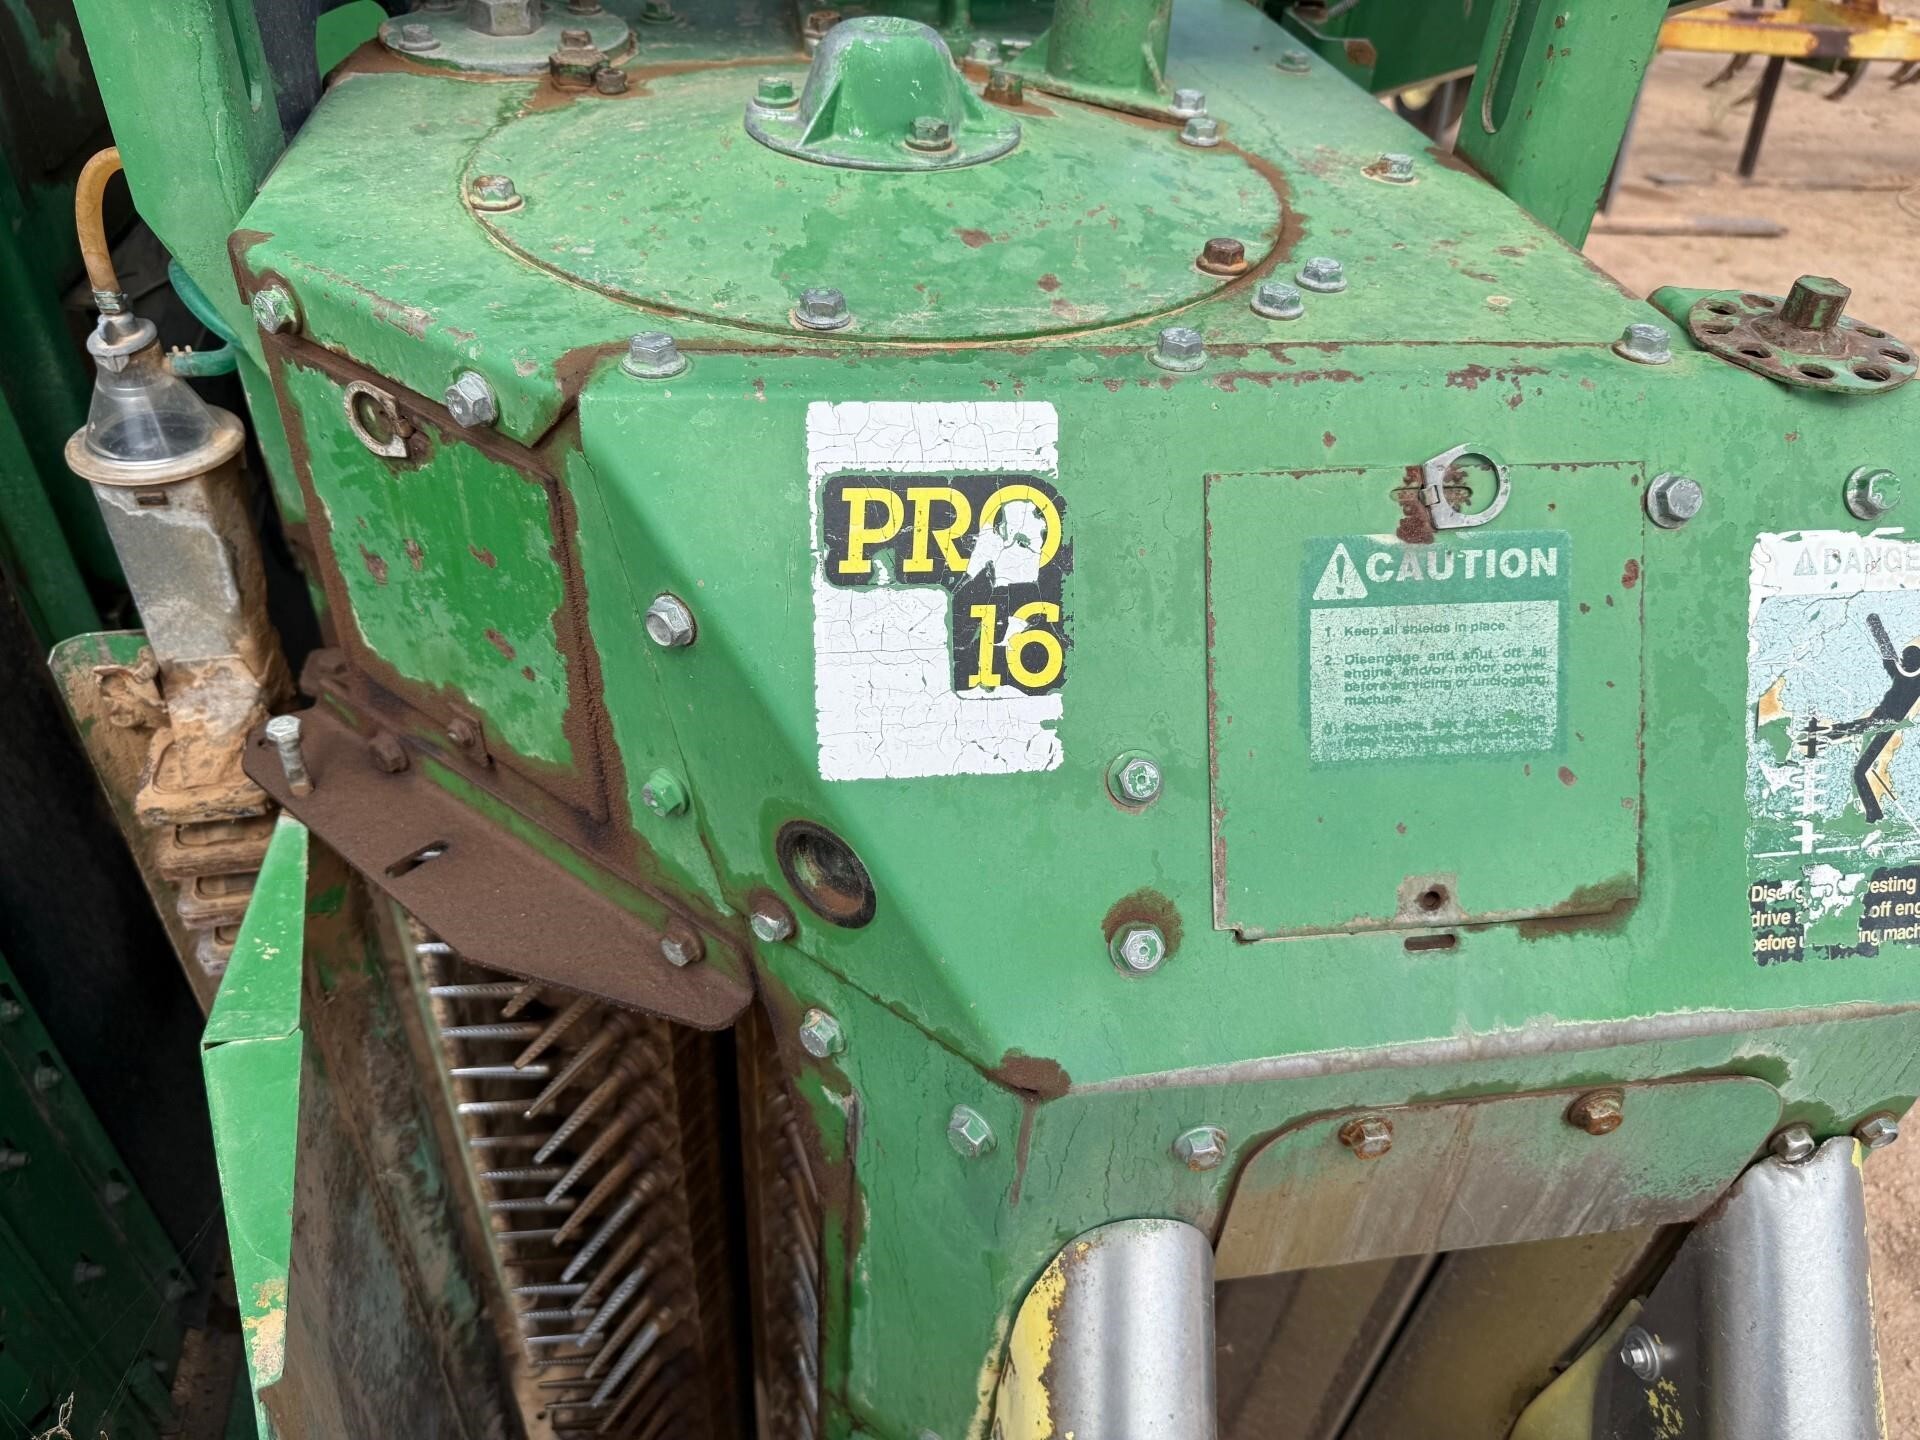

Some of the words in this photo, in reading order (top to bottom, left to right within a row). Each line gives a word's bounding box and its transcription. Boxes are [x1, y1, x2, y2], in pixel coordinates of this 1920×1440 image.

[838, 484, 1063, 574] PRO
[1365, 547, 1558, 583] CAUTION
[1823, 545, 1920, 575] DANGE
[1344, 625, 1379, 638] Keep
[1382, 624, 1398, 635] all
[1402, 623, 1451, 635] shields
[1455, 622, 1469, 632] in
[968, 600, 1063, 688] 16
[1344, 652, 1421, 668] Disengage
[1427, 650, 1456, 662] and
[1462, 648, 1493, 660] shut
[1344, 667, 1393, 681] engine
[1454, 662, 1496, 674] motor
[1455, 679, 1470, 689] or
[1751, 911, 1791, 928] drive
[1870, 901, 1892, 918] off
